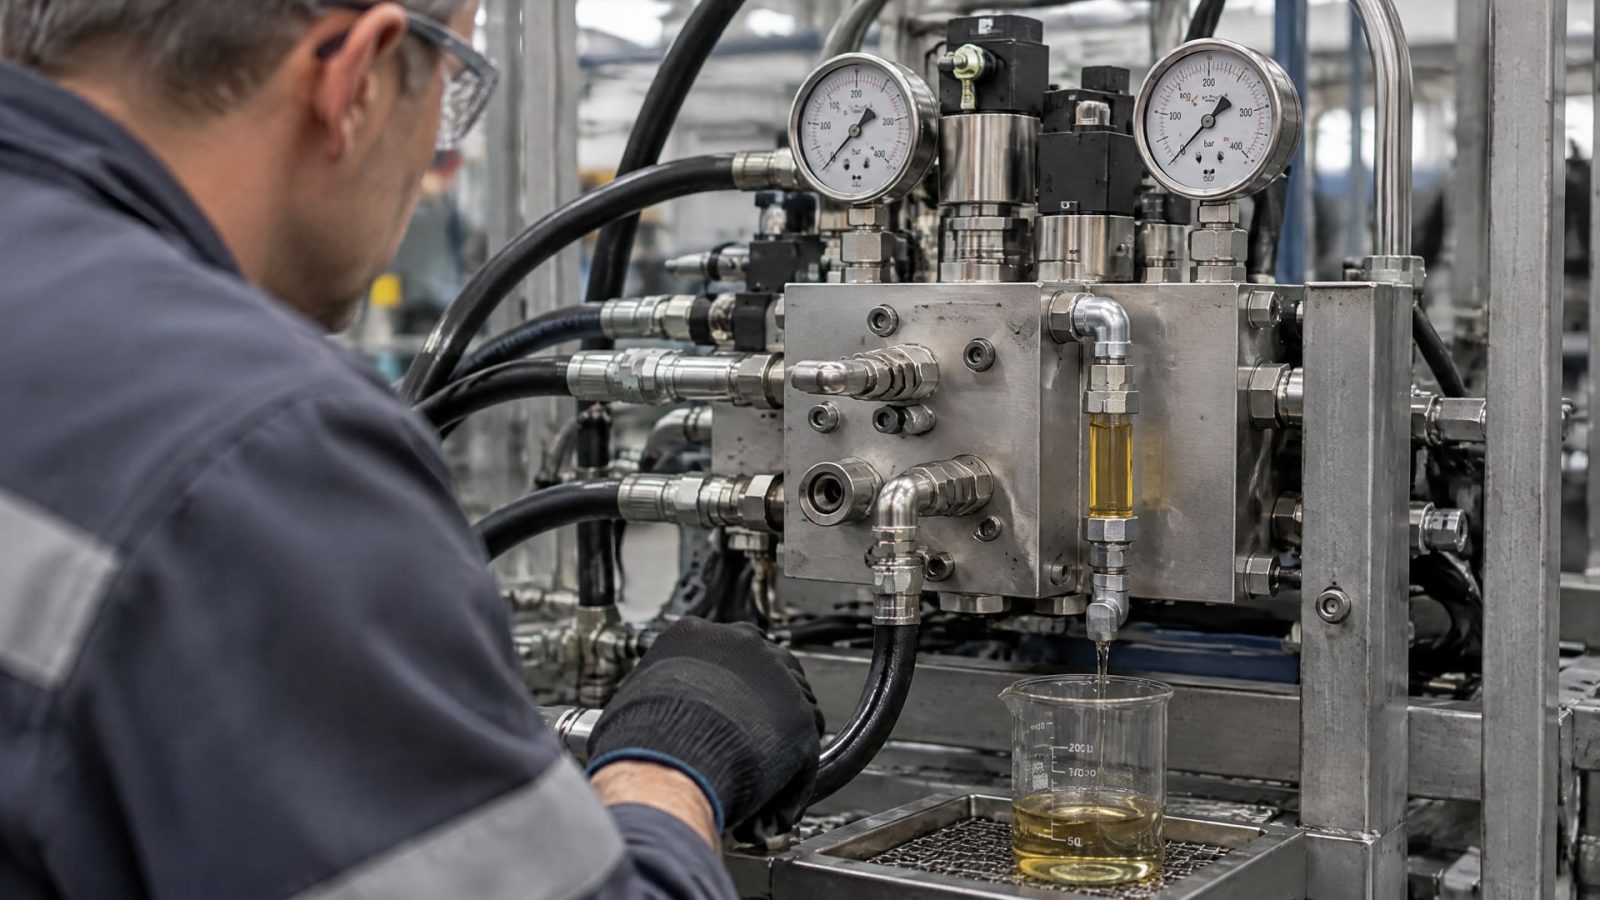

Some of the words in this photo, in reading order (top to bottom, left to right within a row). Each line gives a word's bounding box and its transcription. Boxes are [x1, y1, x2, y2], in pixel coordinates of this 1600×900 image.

[1202, 78, 1215, 87] 200
[850, 90, 862, 98] 200
[1239, 108, 1252, 117] 300
[1229, 142, 1243, 150] 400
[874, 149, 886, 158] 400
